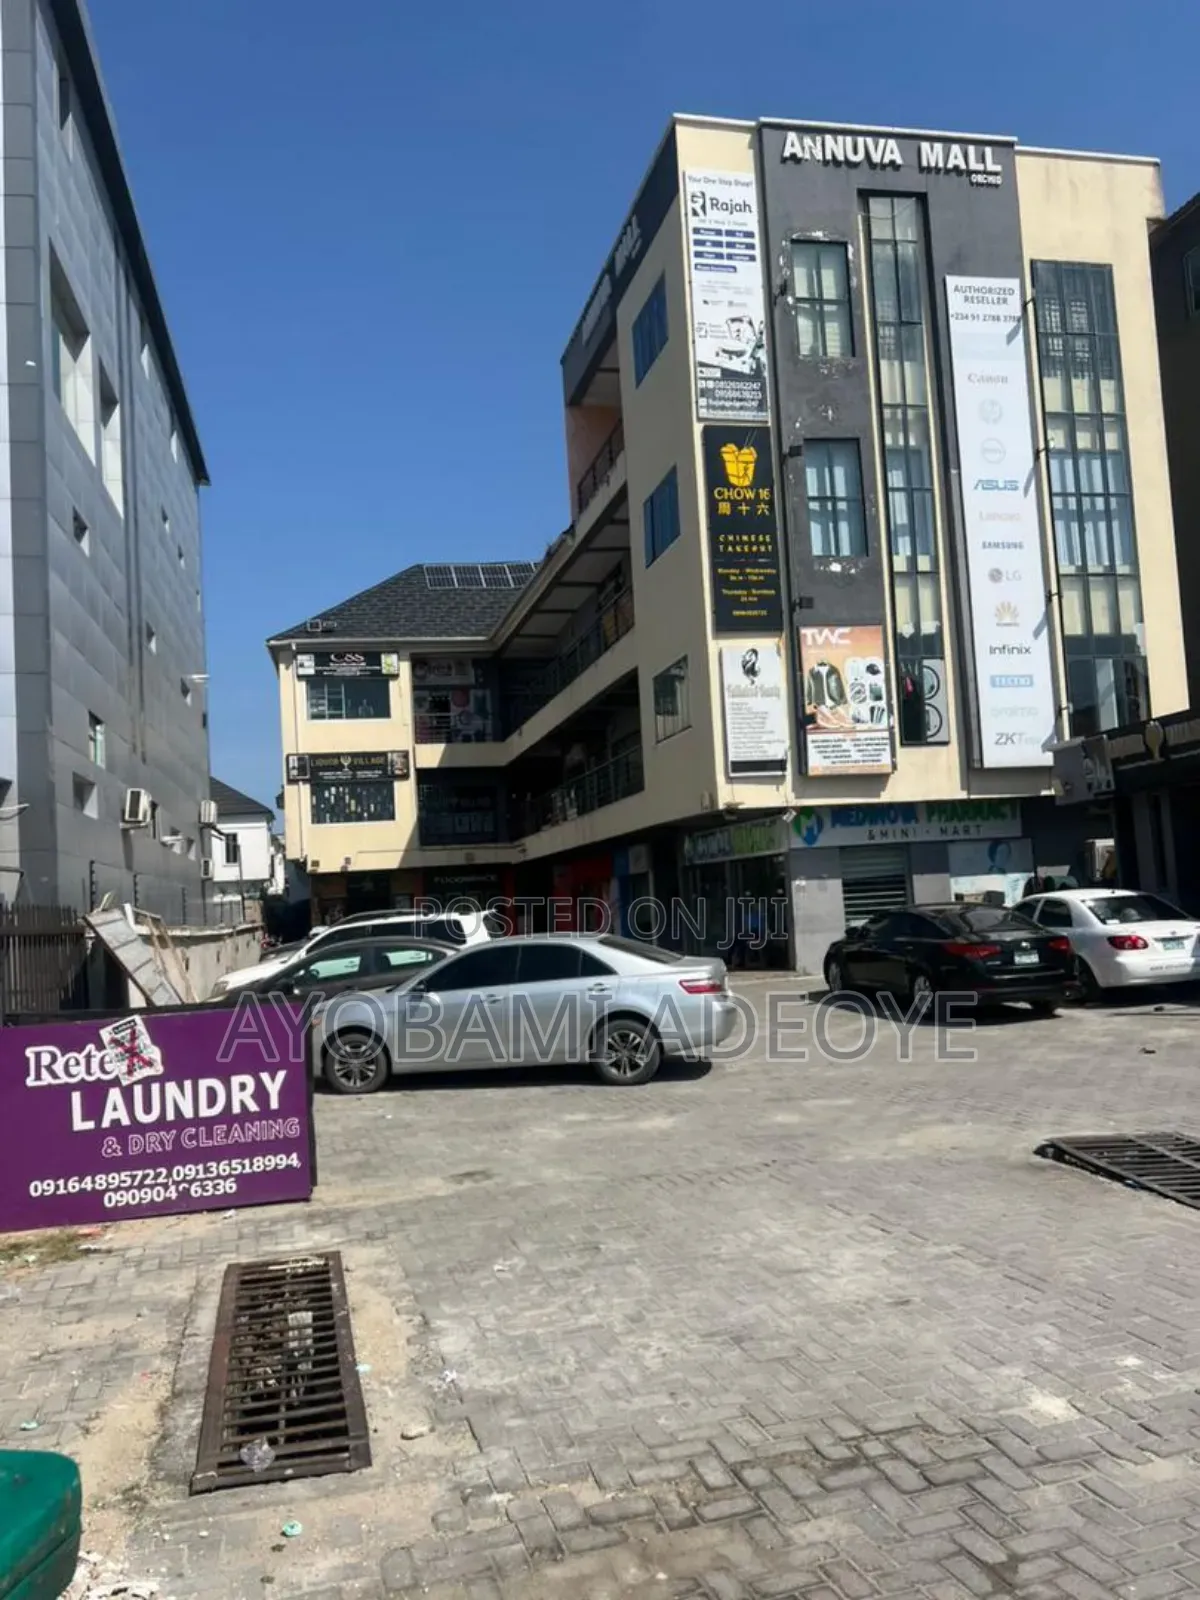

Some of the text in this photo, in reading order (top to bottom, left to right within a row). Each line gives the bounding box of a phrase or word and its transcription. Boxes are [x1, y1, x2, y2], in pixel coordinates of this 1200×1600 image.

[783, 131, 1002, 172] ANNUVA MALL
[970, 173, 1002, 185] ORCHID
[709, 197, 753, 215] Rajah
[953, 284, 1015, 297] AUTHORIZED
[963, 294, 1009, 305] RESELLER
[967, 372, 1009, 385] Canon
[973, 479, 1020, 491] ASUS
[713, 487, 755, 500] CHOW
[718, 533, 772, 543] CHINESE
[718, 544, 773, 553] TAKEOUT
[981, 541, 1024, 550] SAMSUNG
[1005, 570, 1021, 581] LG
[801, 627, 851, 645] TWC
[989, 643, 1032, 655] Infinix
[939, 824, 984, 837] MART
[71, 1070, 287, 1132] LAUNDRY
[101, 1117, 300, 1158] & DRY CLEANING
[103, 1177, 237, 1208] 0909046336
